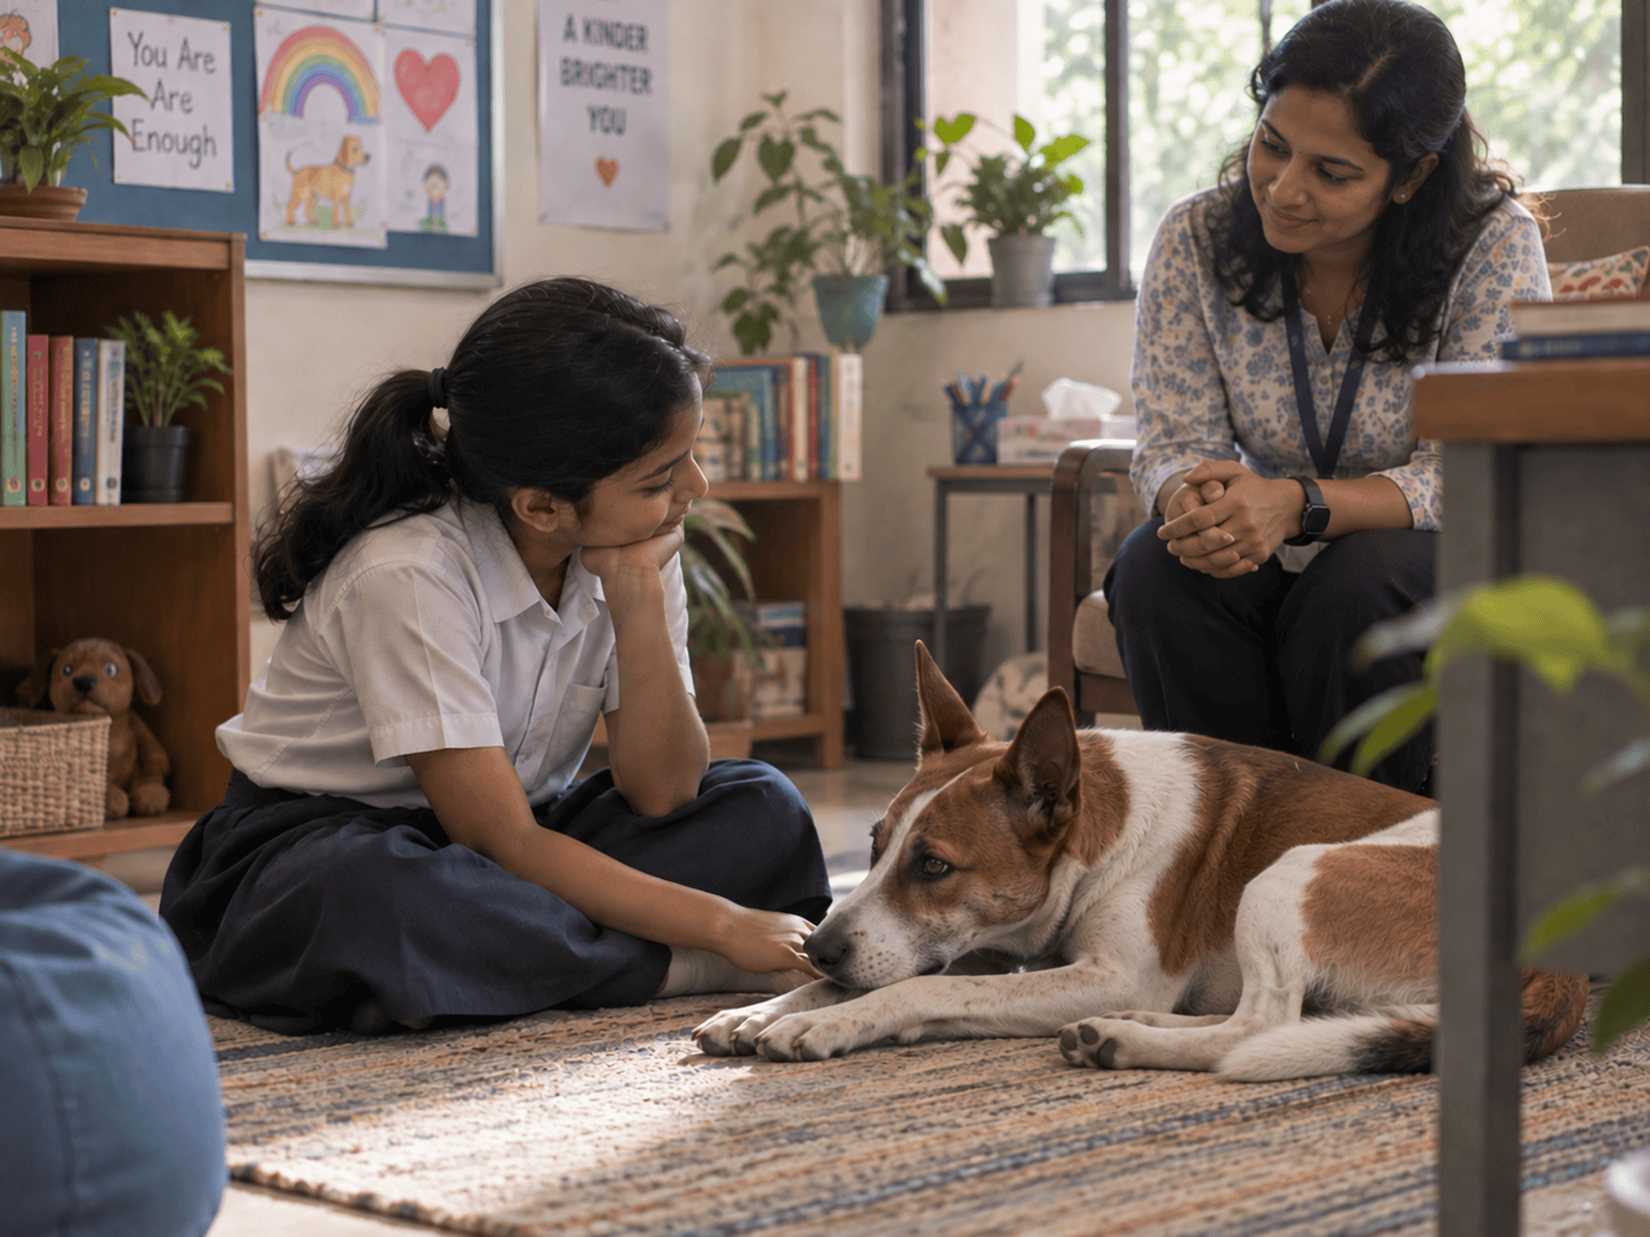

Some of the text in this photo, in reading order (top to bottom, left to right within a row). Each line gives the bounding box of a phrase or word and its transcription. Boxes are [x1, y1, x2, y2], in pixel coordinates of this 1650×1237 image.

[562, 14, 648, 52] A KINDER
[127, 31, 216, 74] You Are
[560, 57, 652, 95] BRIGHTER
[151, 78, 193, 114] Are
[586, 105, 627, 135] YOU
[131, 118, 217, 170] Enough
